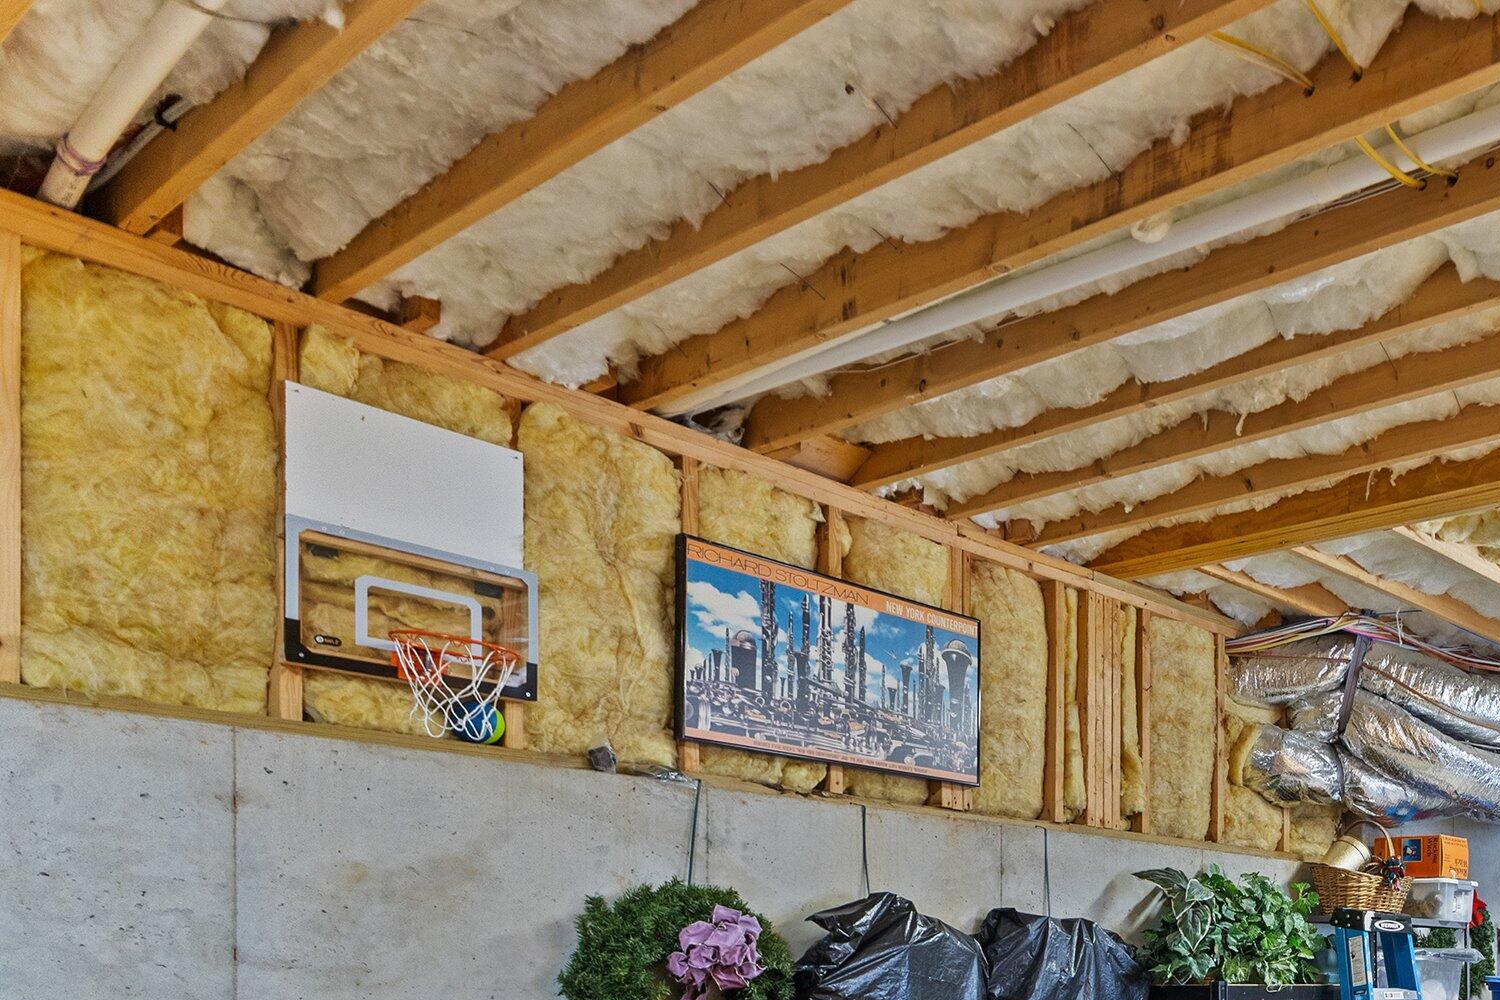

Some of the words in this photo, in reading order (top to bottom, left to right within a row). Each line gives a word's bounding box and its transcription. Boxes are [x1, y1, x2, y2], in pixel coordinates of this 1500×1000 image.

[687, 542, 771, 577] RICHARD
[775, 568, 868, 606] STOLTZMAN
[886, 600, 903, 616] NEW
[905, 604, 924, 621] YORK
[926, 610, 977, 635] COUNTERPOINT
